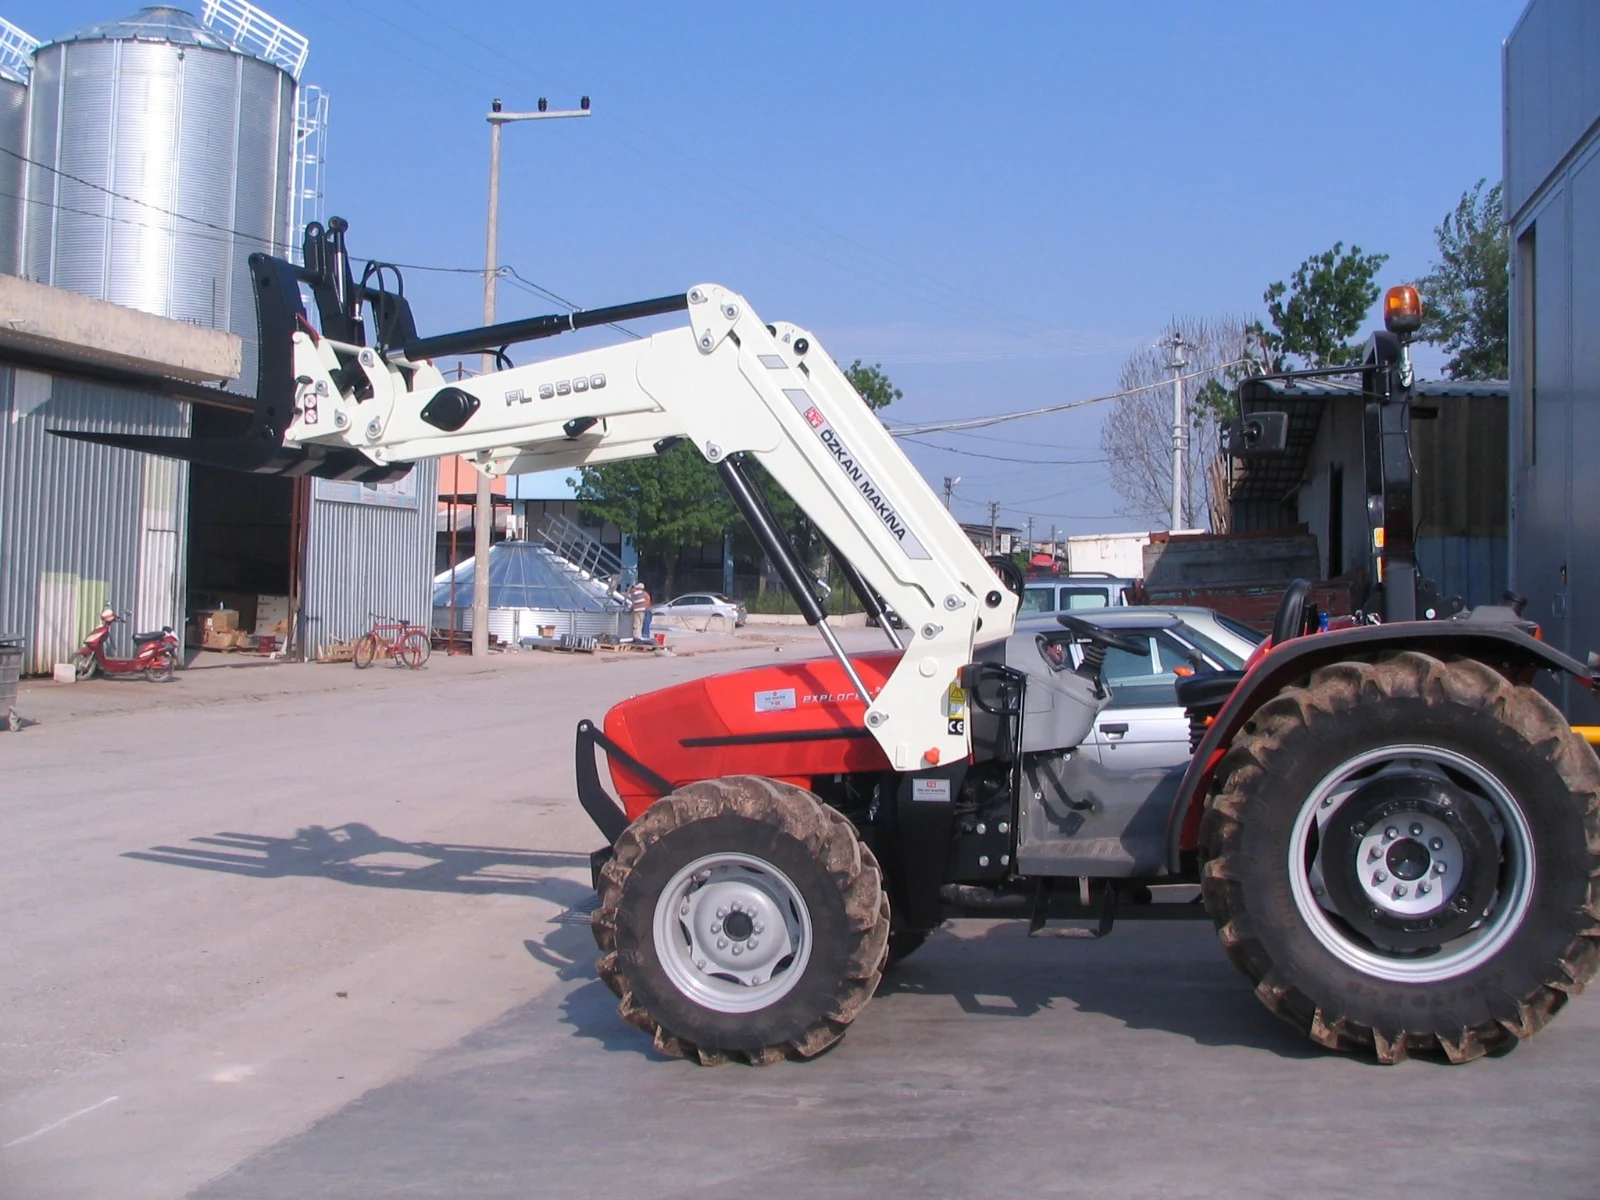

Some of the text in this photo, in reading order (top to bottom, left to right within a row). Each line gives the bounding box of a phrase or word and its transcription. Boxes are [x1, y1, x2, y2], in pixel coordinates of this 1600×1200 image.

[505, 373, 606, 406] FL 3500
[821, 429, 906, 541] ÖZKAN MAKİNA
[949, 721, 963, 733] CE
